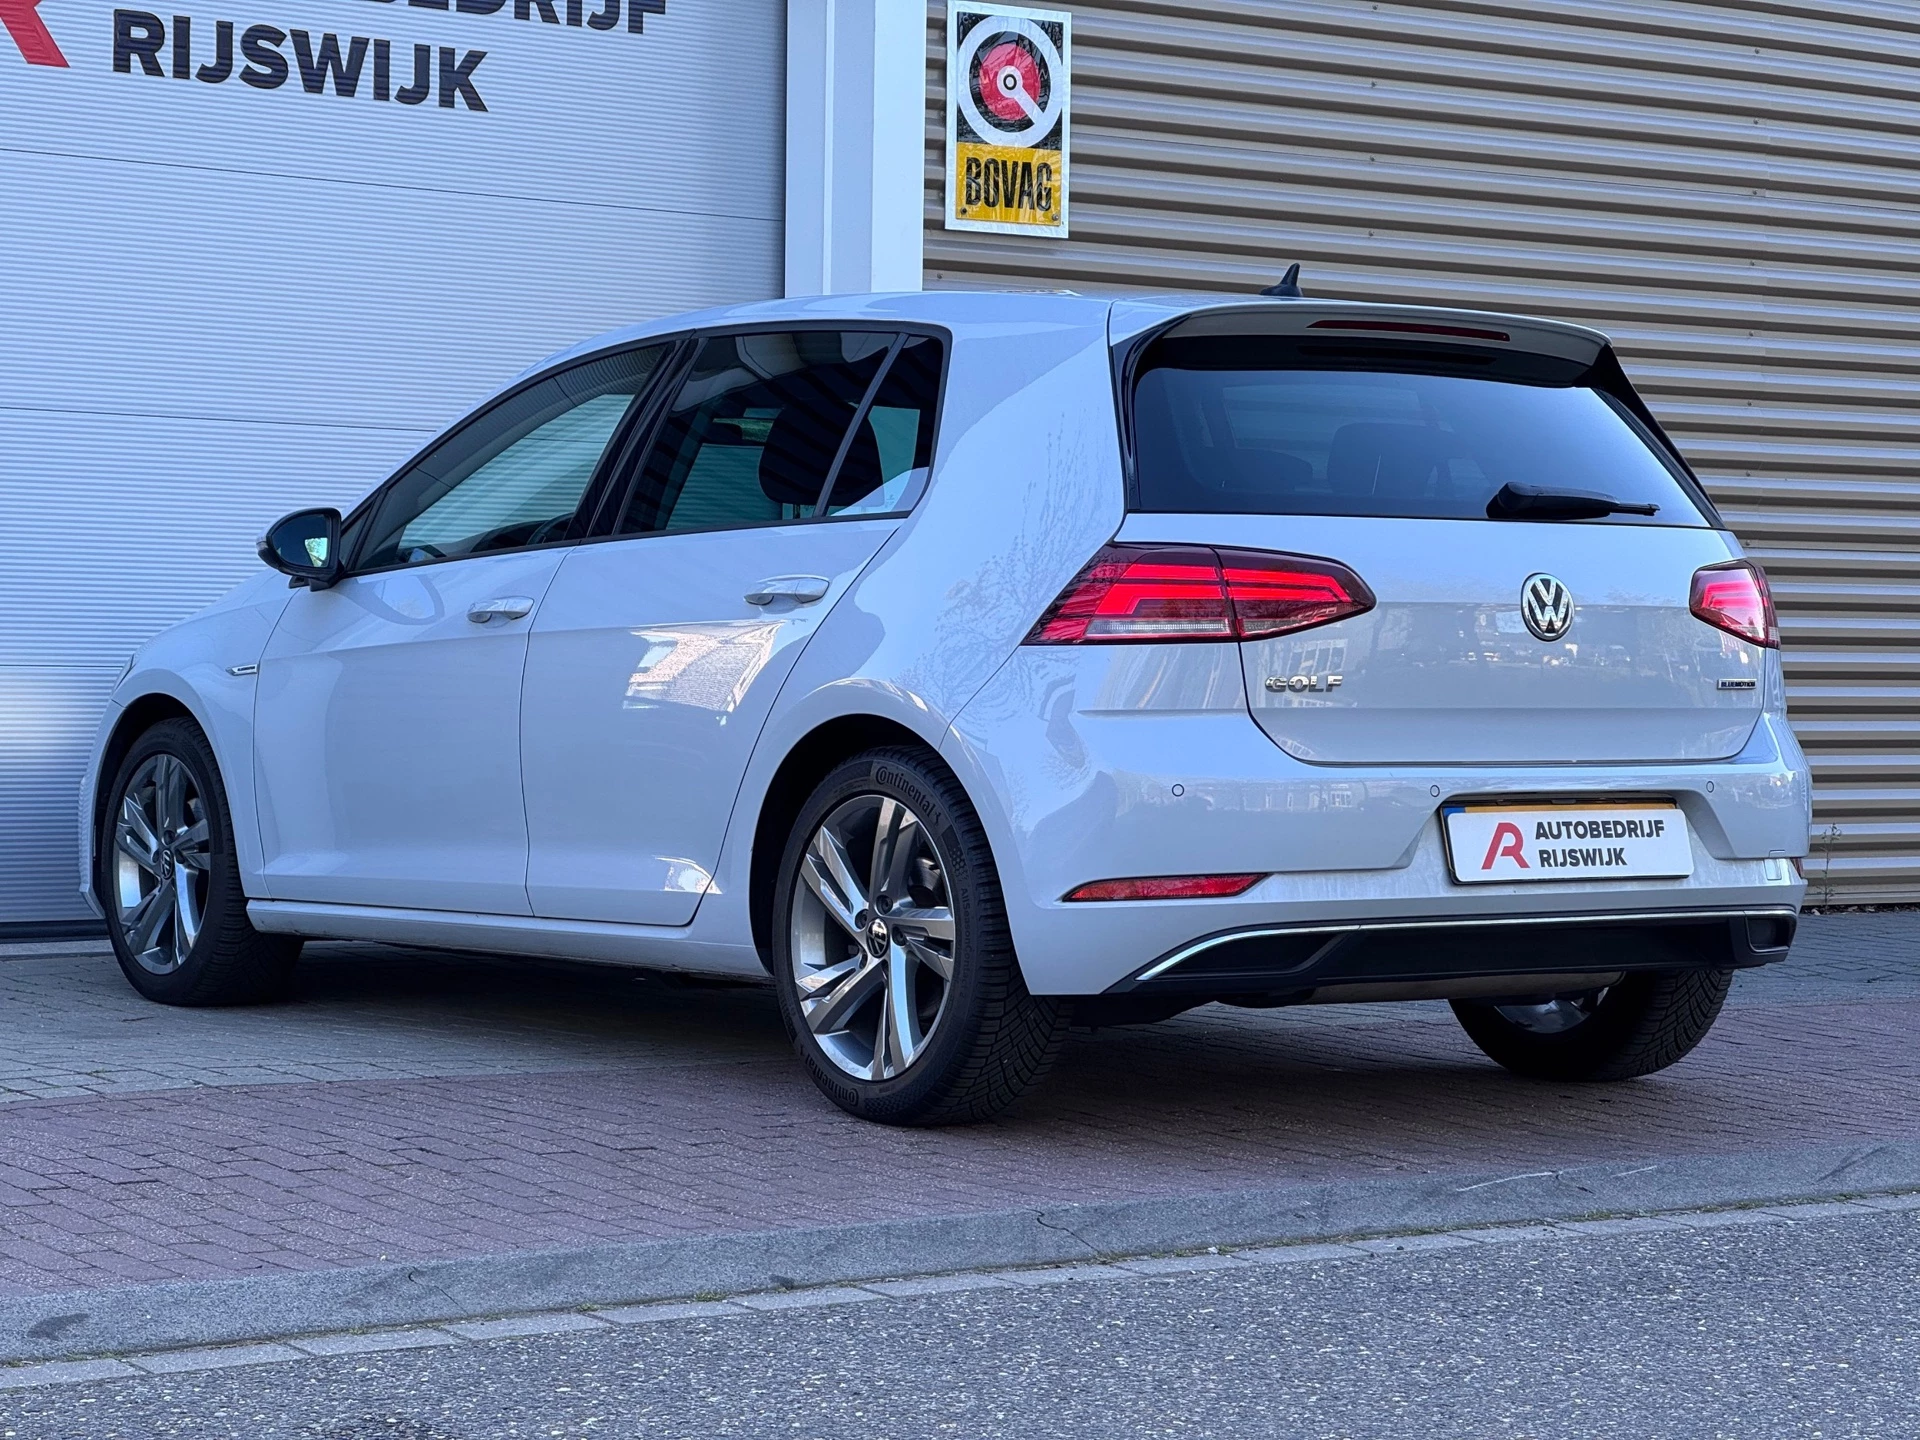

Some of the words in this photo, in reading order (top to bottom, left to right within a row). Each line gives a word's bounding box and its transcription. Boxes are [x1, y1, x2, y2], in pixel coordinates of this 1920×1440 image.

[112, 8, 489, 112] RIJSWIJK
[965, 156, 1053, 212] BOVAG
[1265, 675, 1343, 693] GOLF
[875, 766, 933, 818] Continental
[1535, 820, 1665, 840] AUTOBEDRIJF
[1539, 848, 1627, 868] RIJSWIJK
